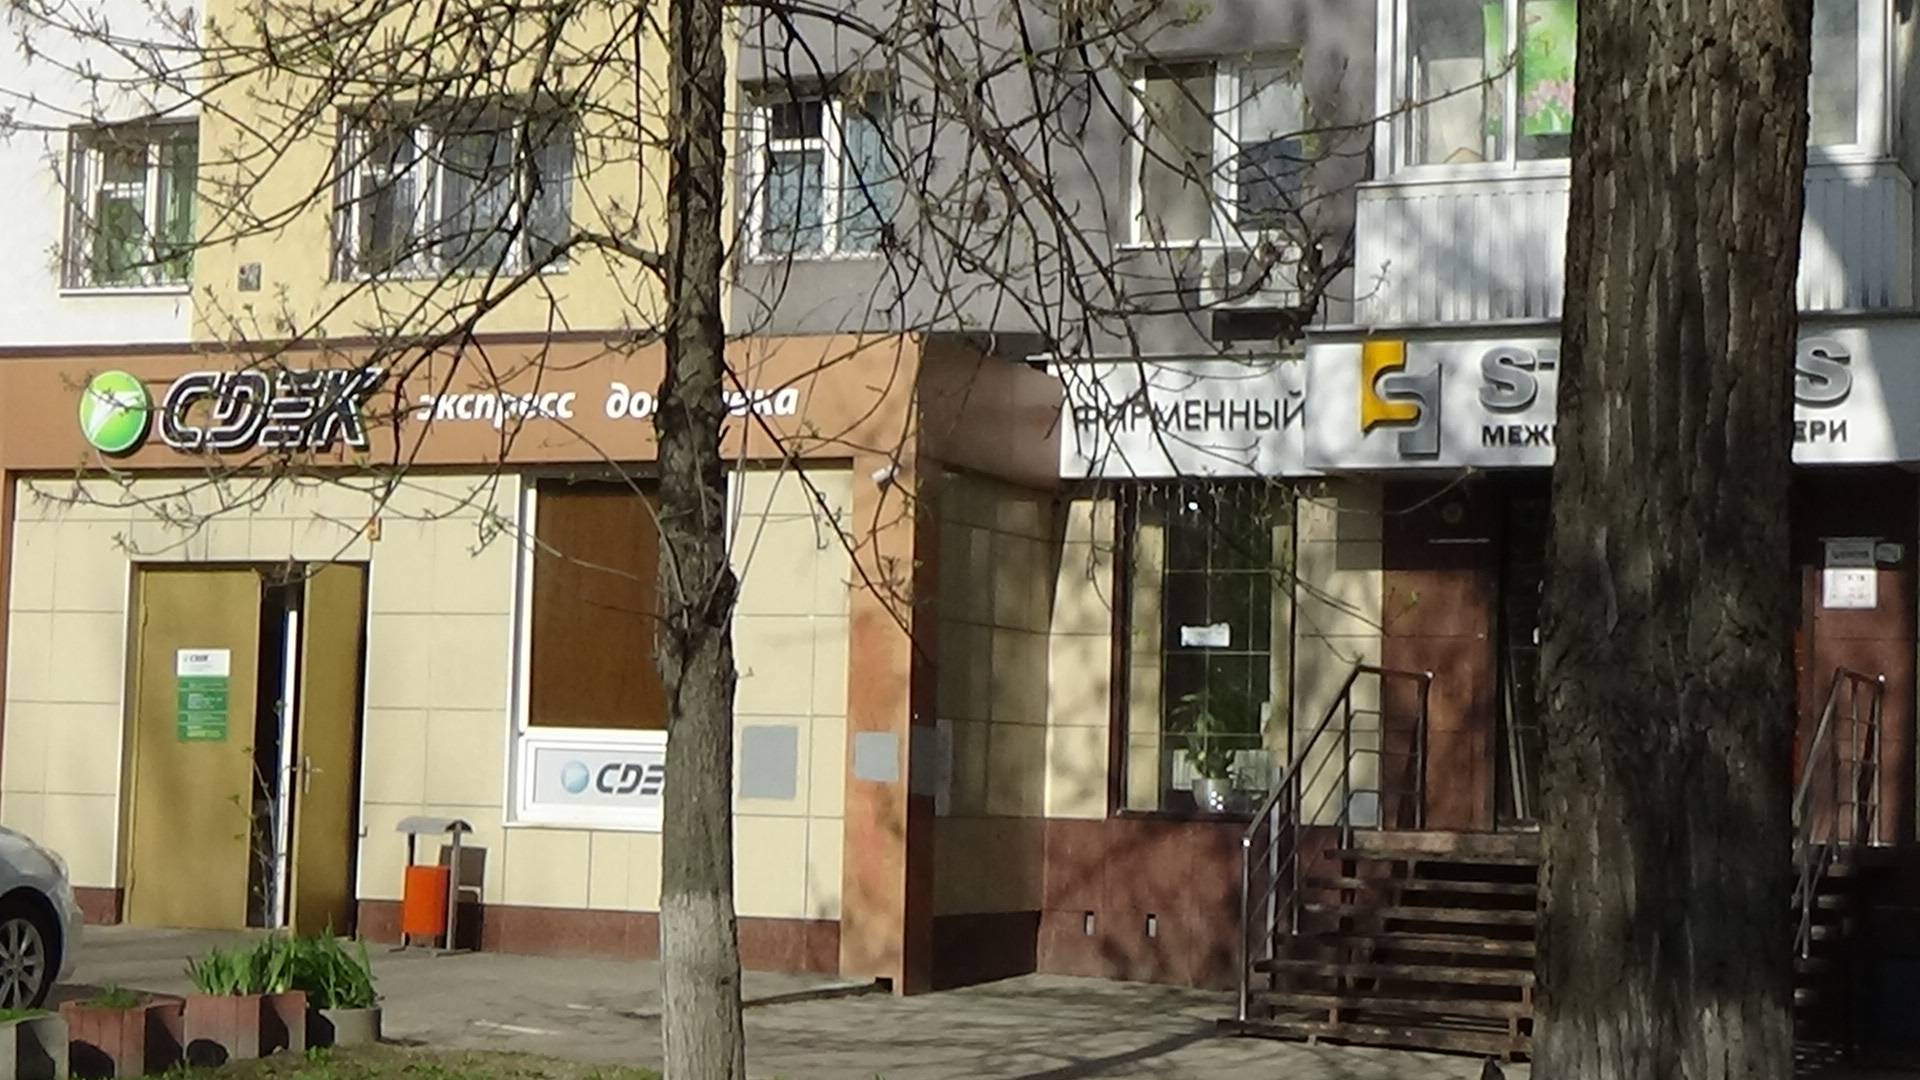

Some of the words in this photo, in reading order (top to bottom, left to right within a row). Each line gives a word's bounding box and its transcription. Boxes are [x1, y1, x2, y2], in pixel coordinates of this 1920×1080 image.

[416, 391, 577, 429] экспресс
[606, 382, 799, 419] довка
[1074, 389, 1306, 432] ФИРМЕННЫЙ
[1482, 424, 1557, 447] МЕЖ
[1794, 419, 1847, 443] ЕРИ
[596, 763, 665, 796] CDE
